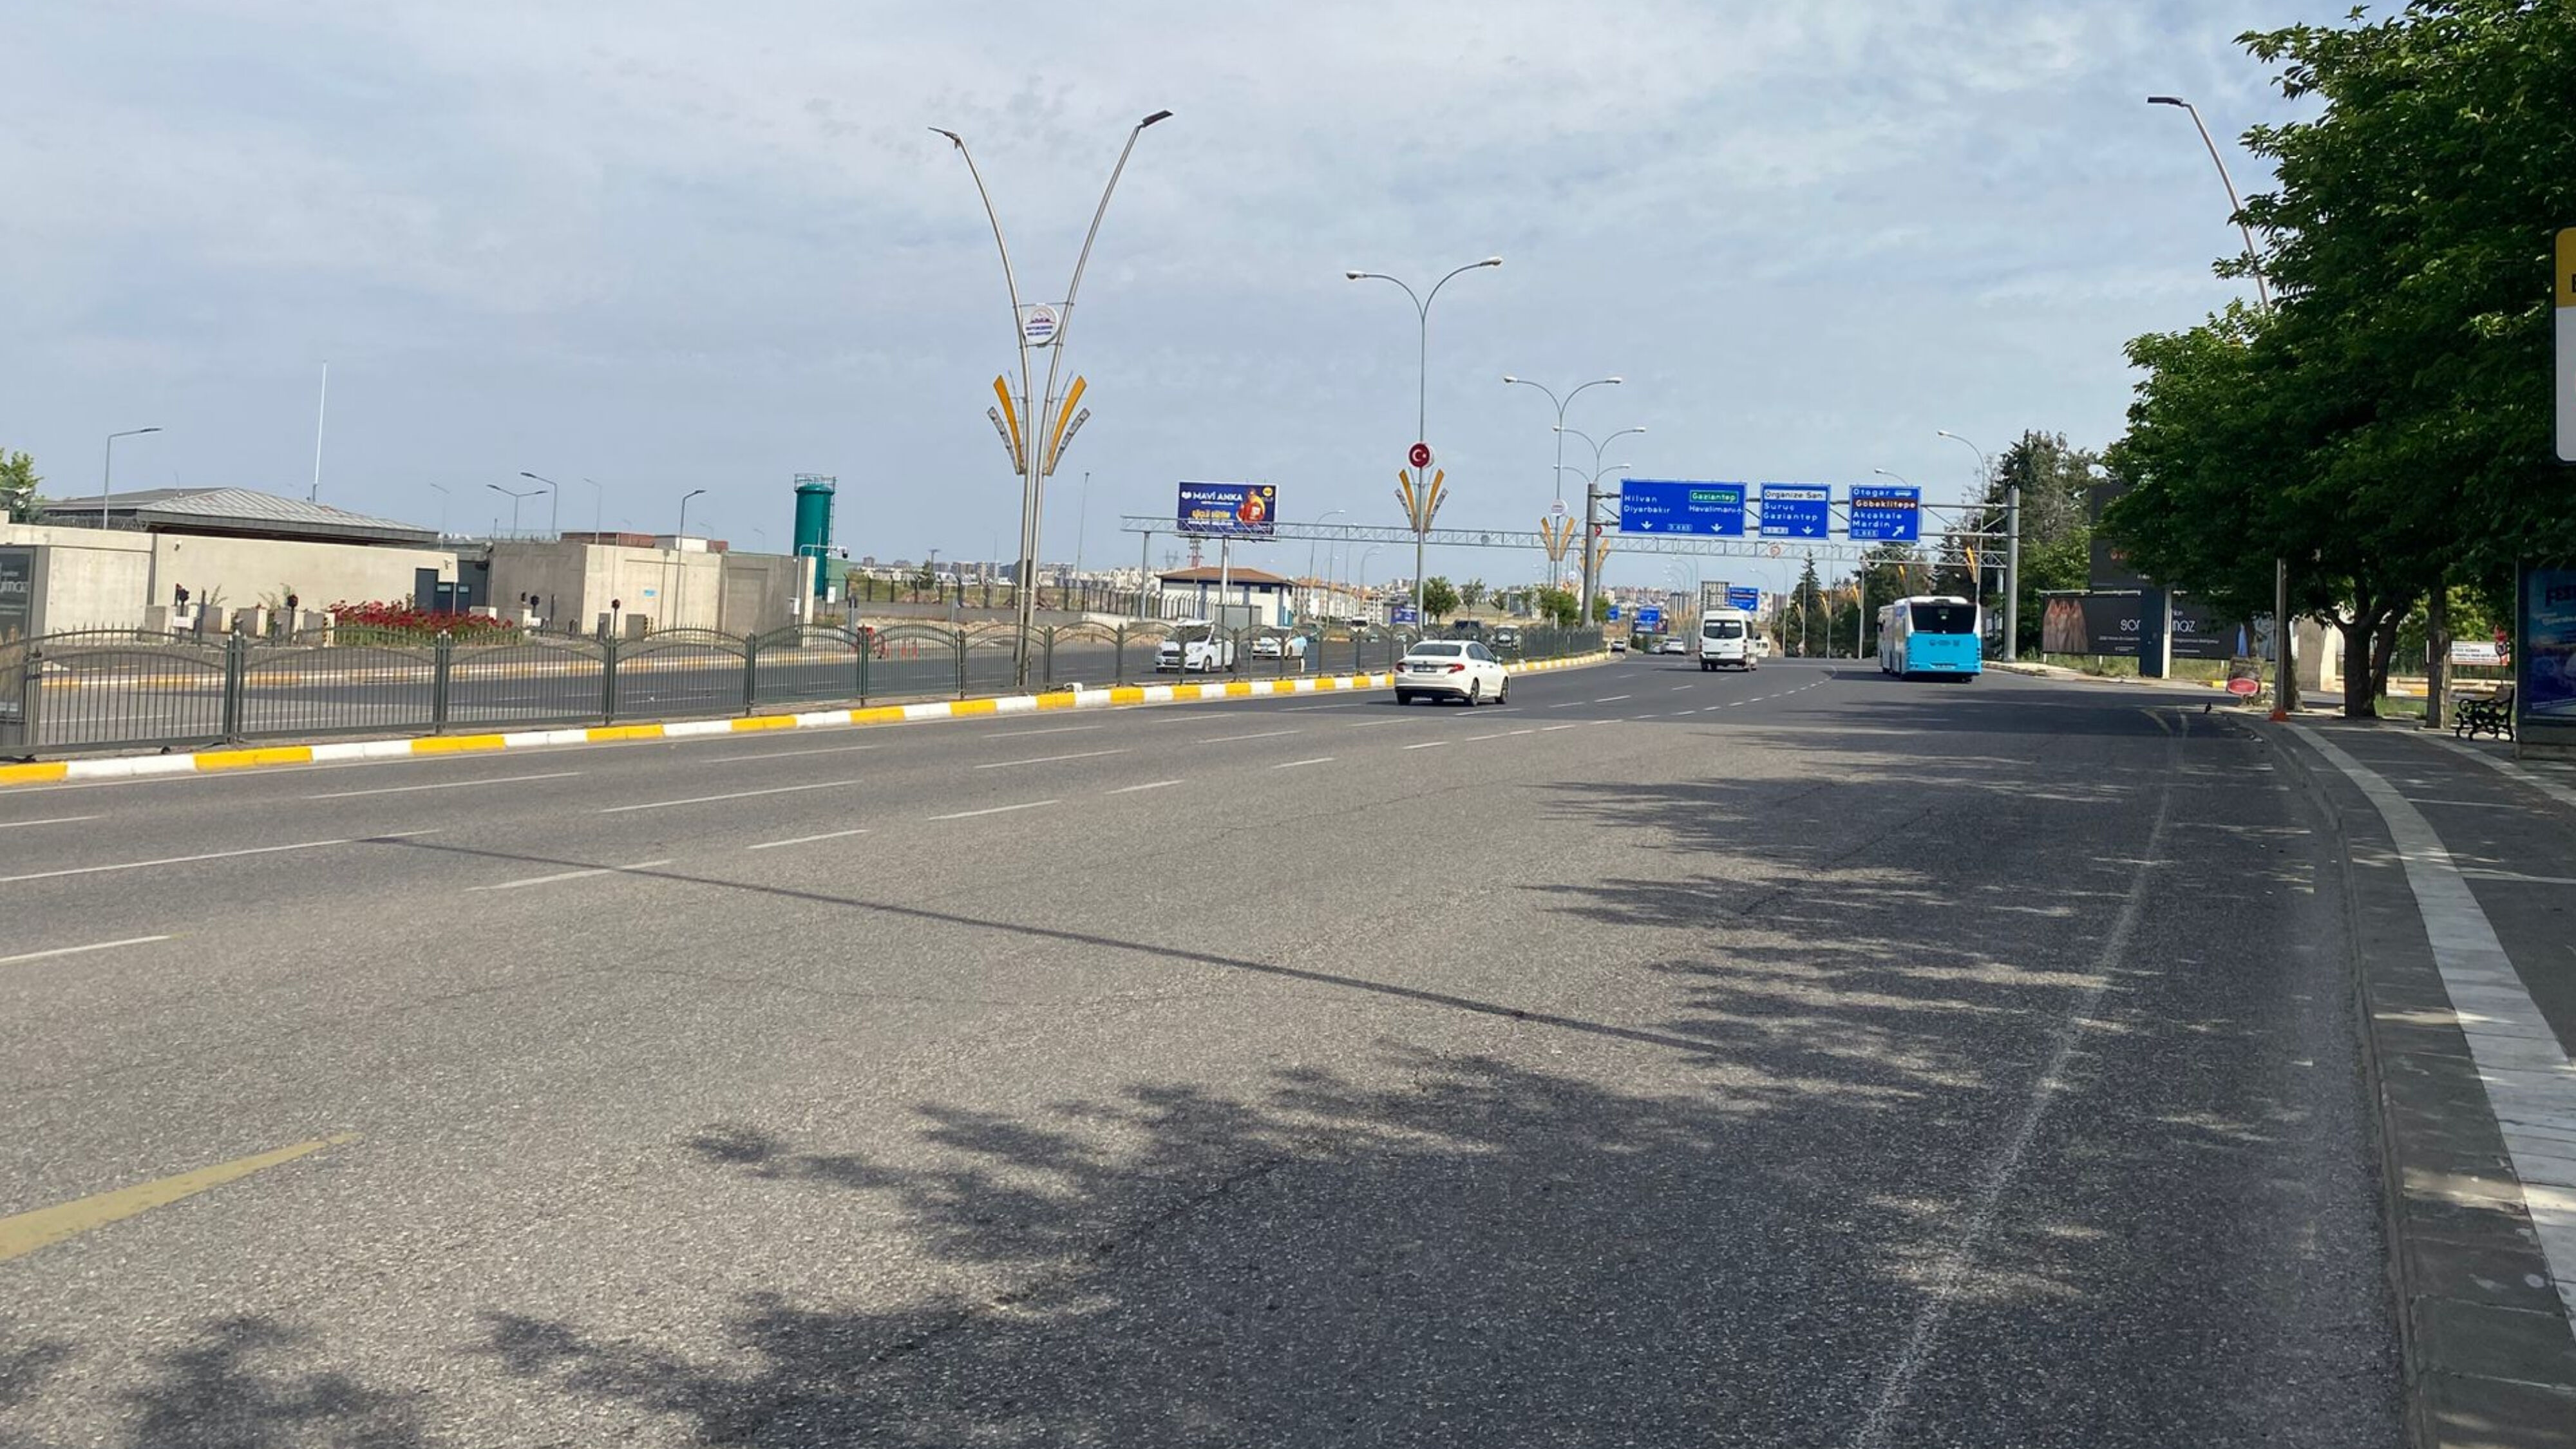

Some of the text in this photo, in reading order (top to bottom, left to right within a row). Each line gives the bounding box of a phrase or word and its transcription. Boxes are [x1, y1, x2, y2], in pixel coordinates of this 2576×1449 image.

[1692, 493, 1736, 502] Gaziantep
[1853, 489, 1889, 497] Otogar
[1763, 511, 1818, 522] Gaziantep
